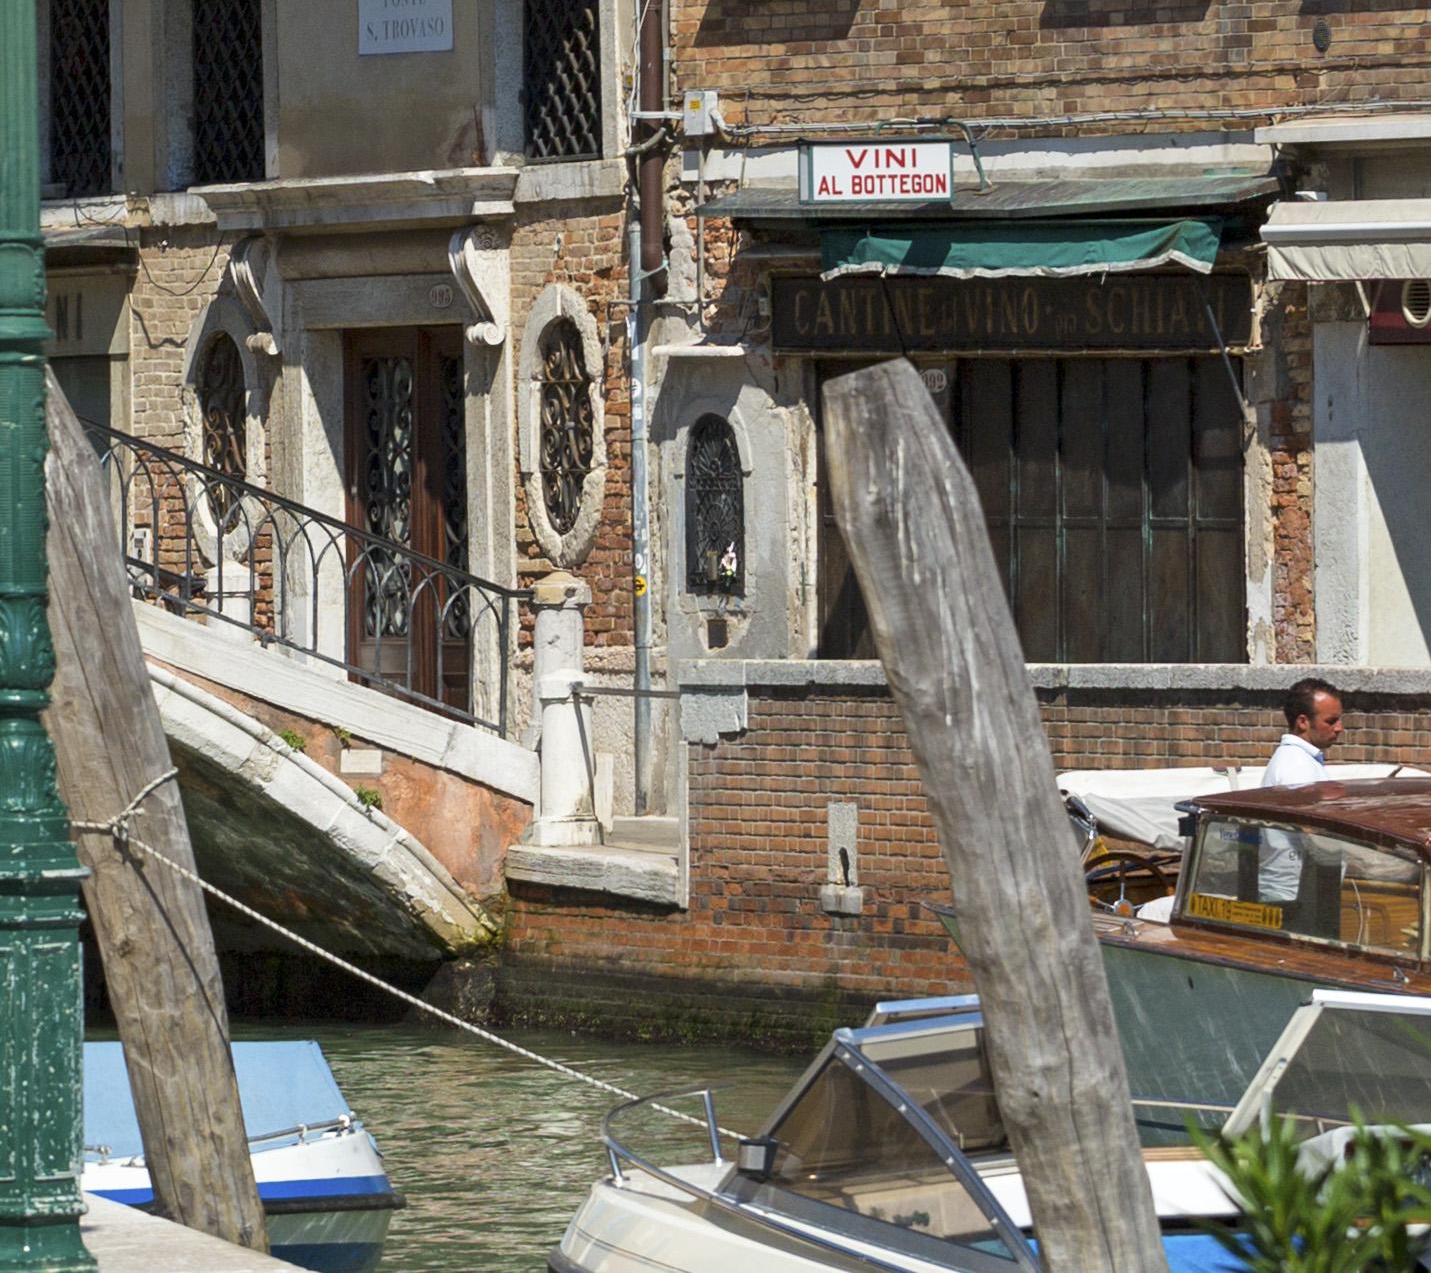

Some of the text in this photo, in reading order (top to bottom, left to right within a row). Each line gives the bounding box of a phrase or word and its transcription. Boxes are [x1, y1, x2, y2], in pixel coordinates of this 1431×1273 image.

[382, 16, 445, 40] TROVASO
[845, 147, 917, 170] VINI
[818, 173, 947, 196] AL BOTTEGON
[794, 286, 936, 336] CANTINE
[965, 286, 1040, 335] VINO
